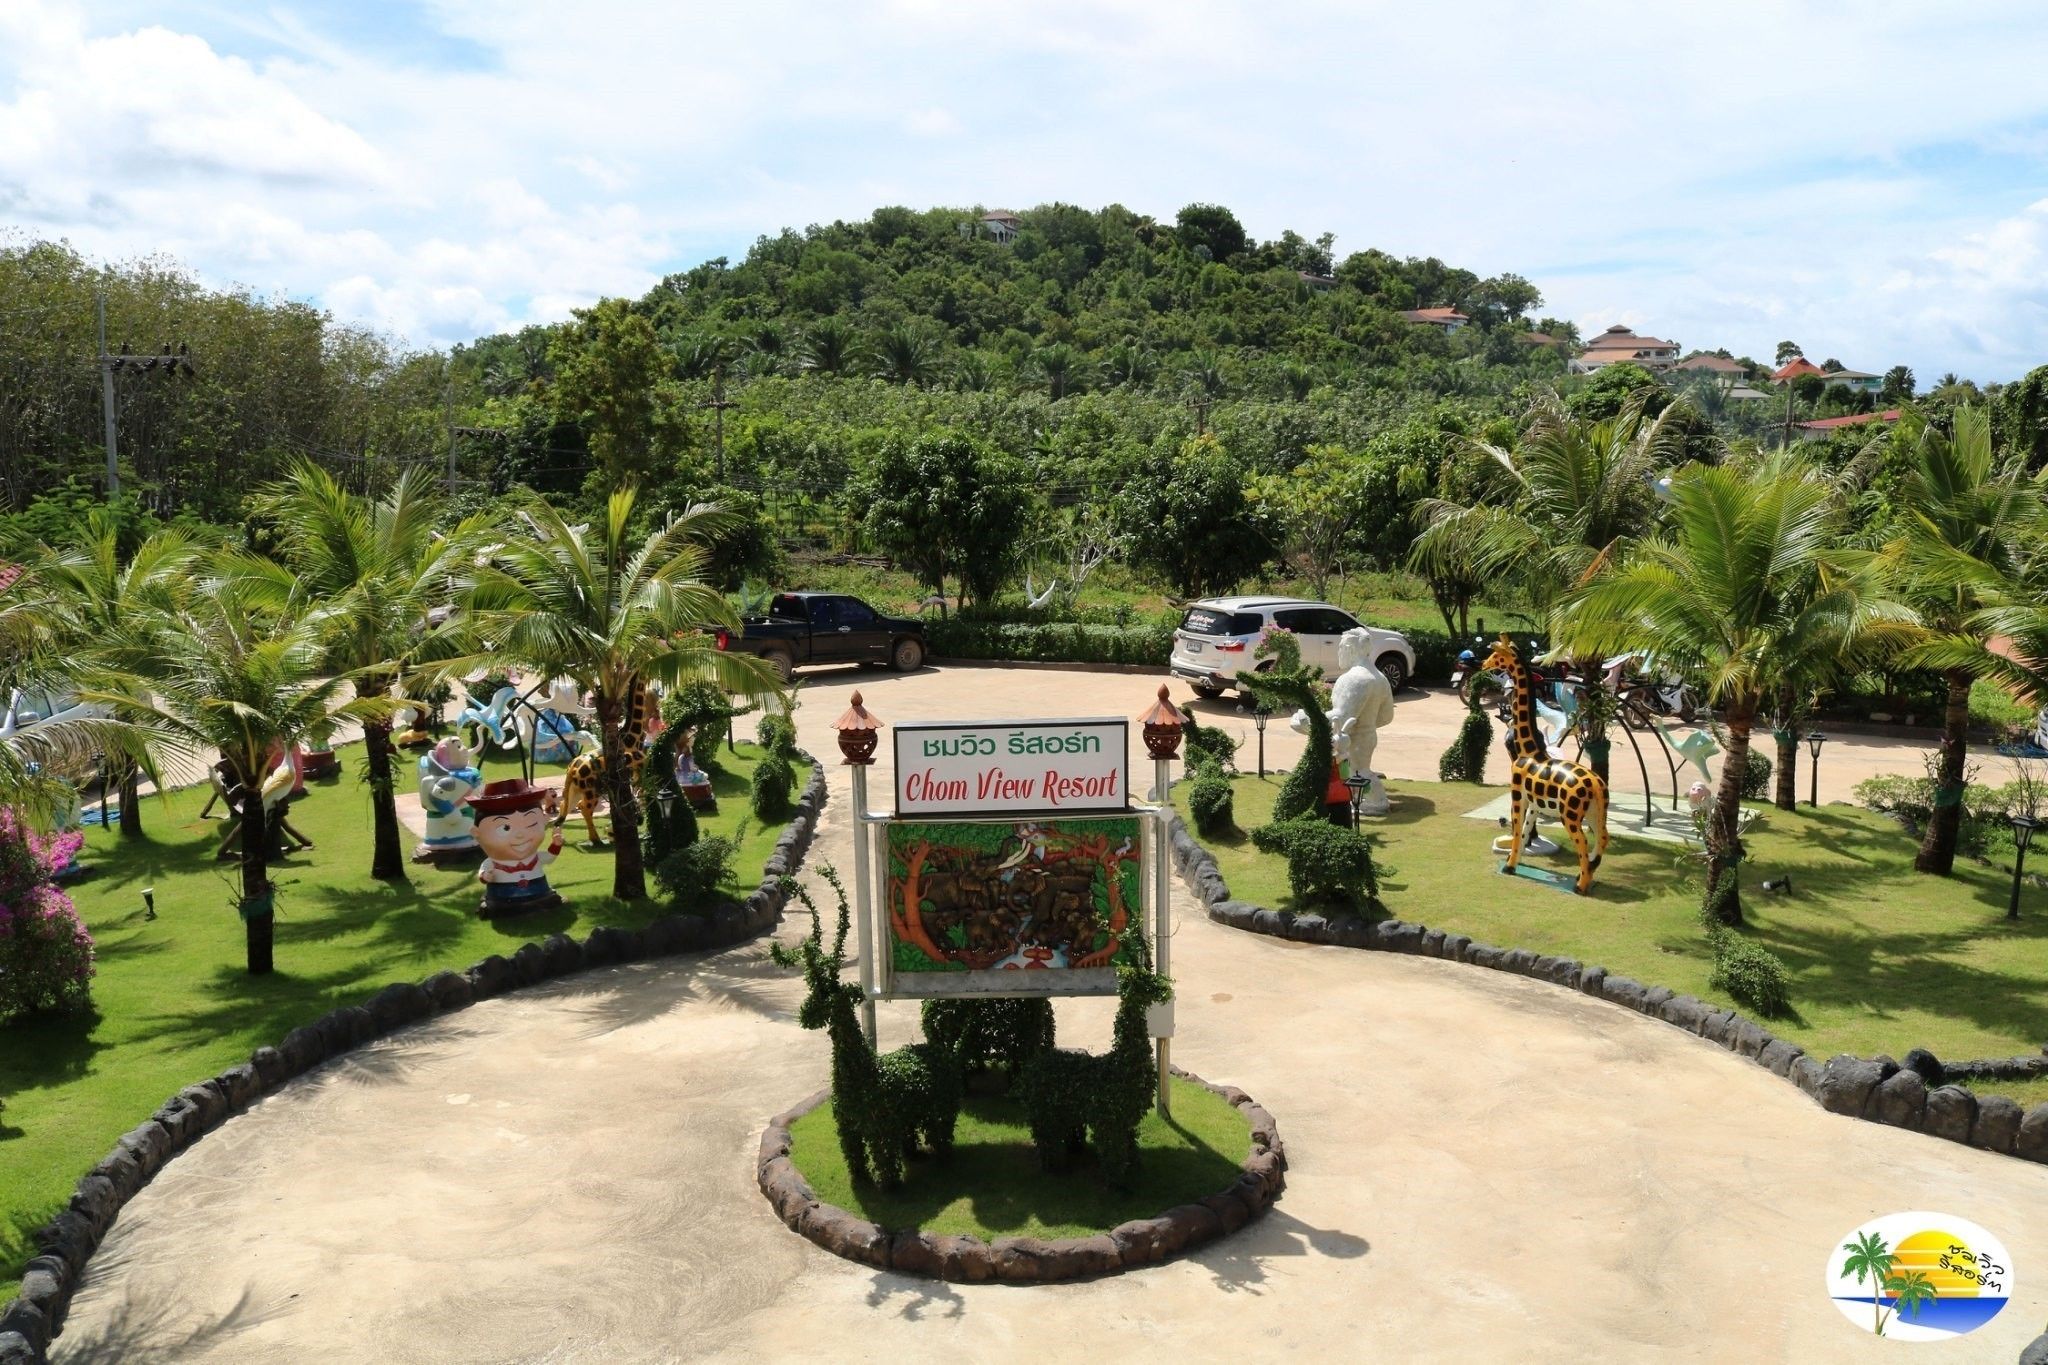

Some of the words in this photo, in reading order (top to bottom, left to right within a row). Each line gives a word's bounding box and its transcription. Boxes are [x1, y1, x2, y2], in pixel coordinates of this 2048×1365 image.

[923, 734, 996, 757] ชมวิว
[1007, 731, 1101, 755] รีสอร์ท
[906, 767, 969, 801] Chom
[977, 767, 1035, 800] View
[1042, 767, 1118, 805] Resort
